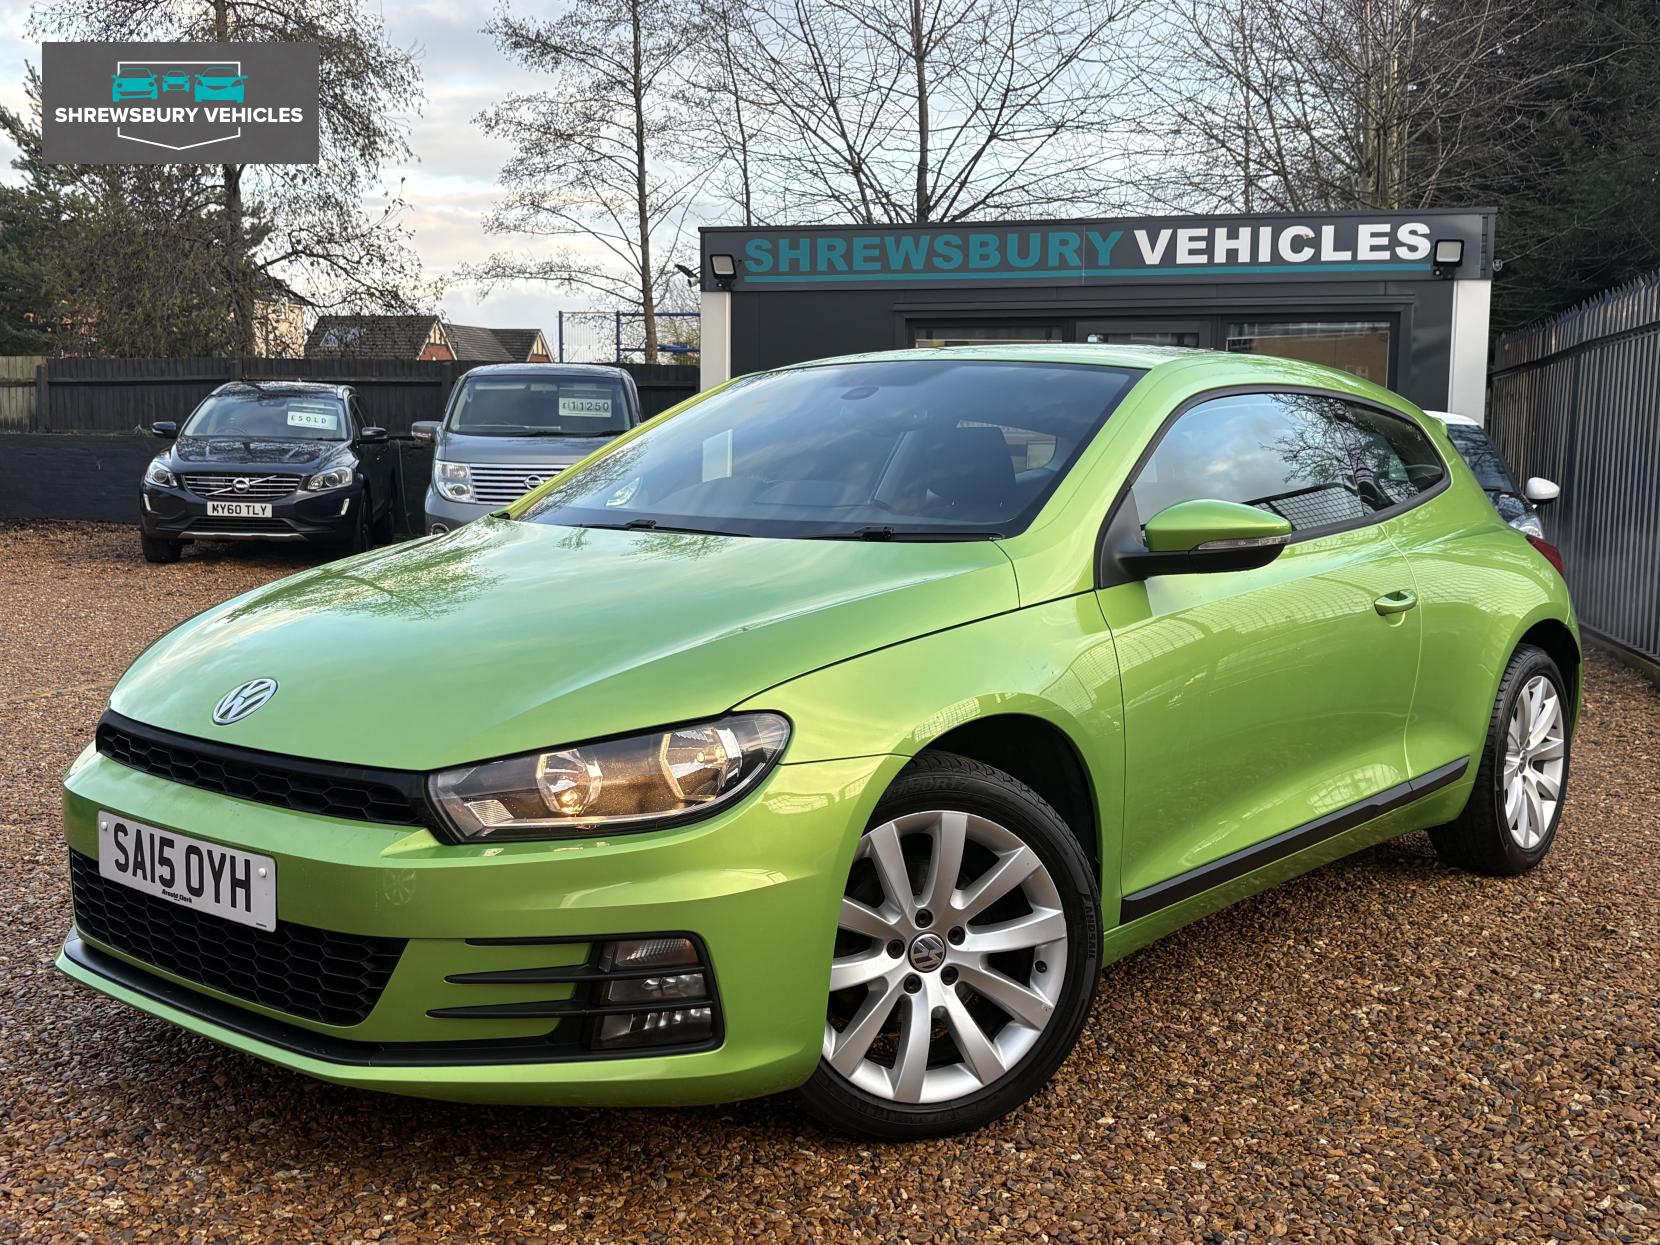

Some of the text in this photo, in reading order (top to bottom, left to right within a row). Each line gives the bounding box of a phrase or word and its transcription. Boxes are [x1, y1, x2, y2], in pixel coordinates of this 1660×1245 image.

[744, 222, 1431, 273] SHREWSBURY VEHICLES
[212, 503, 267, 516] MY60 TLY
[113, 822, 252, 913] SA15 OYH
